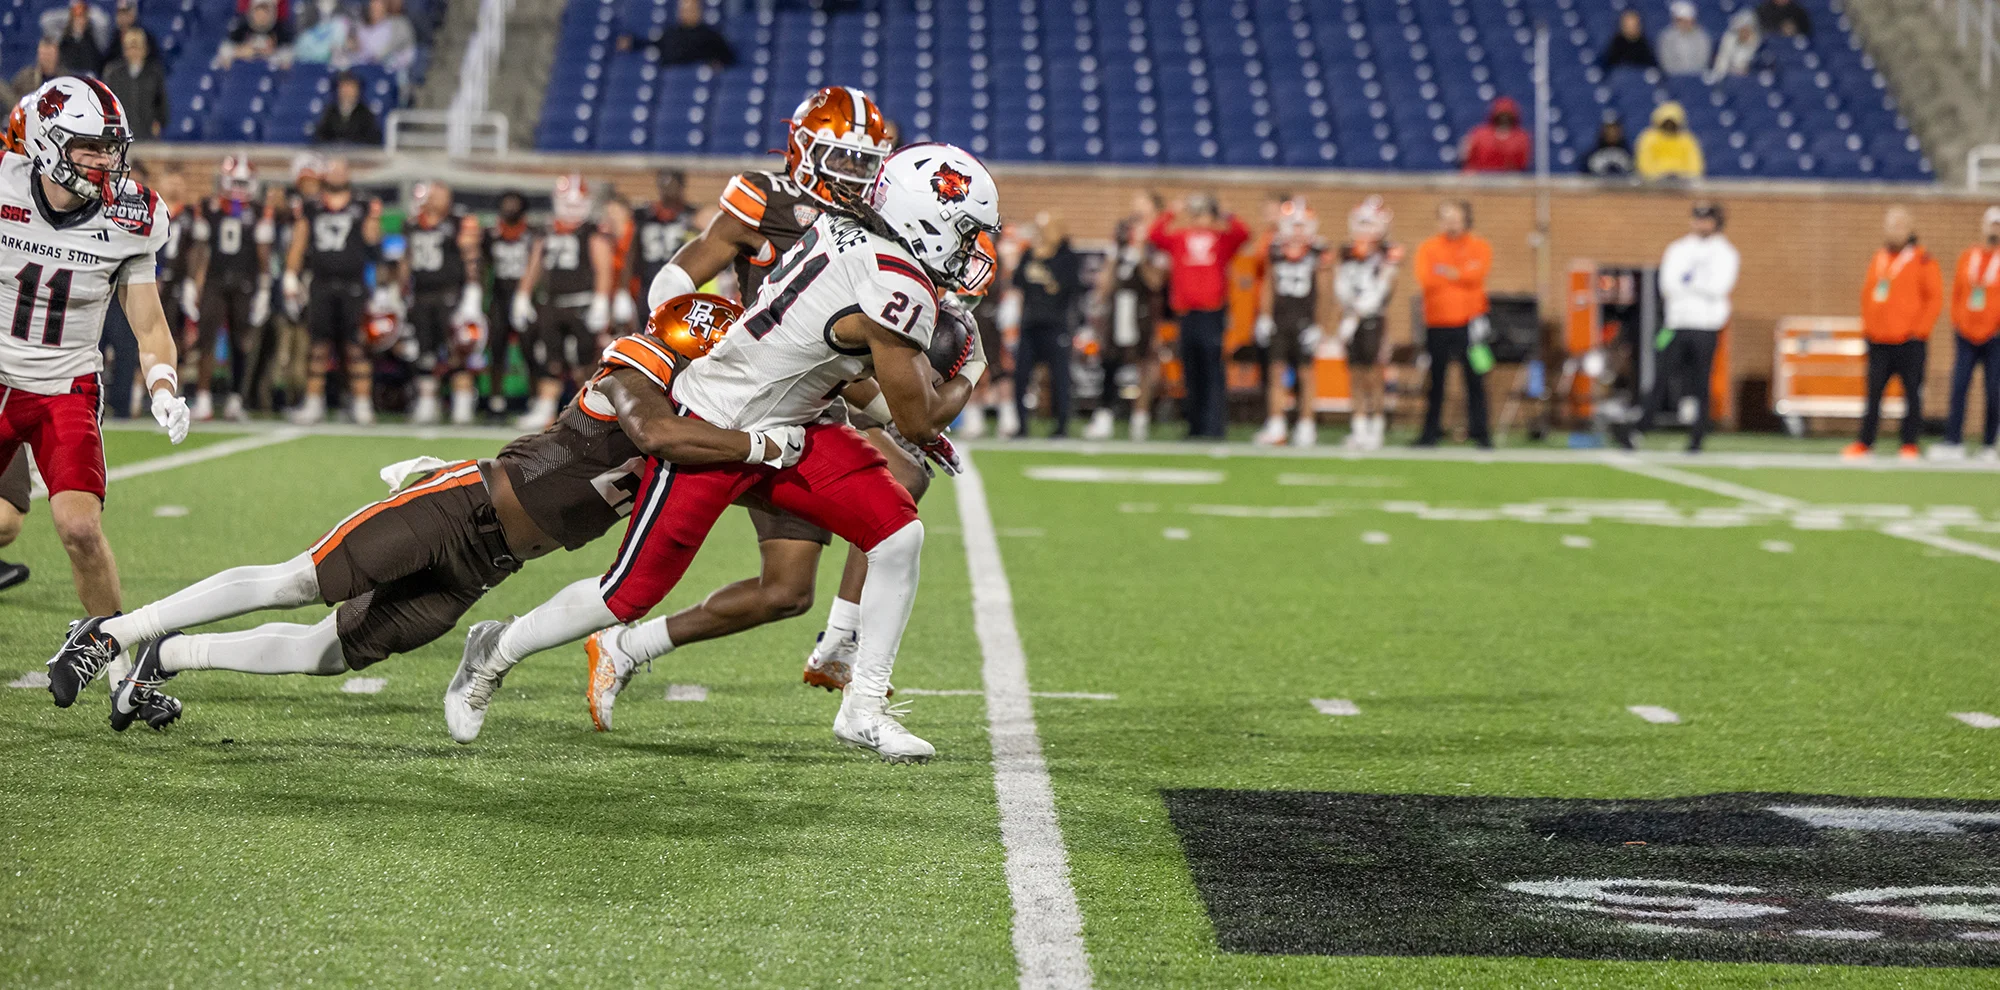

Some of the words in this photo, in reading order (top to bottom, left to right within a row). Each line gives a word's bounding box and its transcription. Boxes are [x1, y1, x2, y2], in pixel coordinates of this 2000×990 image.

[0, 203, 32, 224] SBC
[104, 203, 152, 225] BOWL
[825, 211, 868, 254] ALLACE
[1, 234, 62, 259] ARKANSAS
[67, 249, 100, 265] STATE
[11, 261, 74, 346] 11
[742, 226, 830, 341] 21
[880, 290, 923, 334] 21
